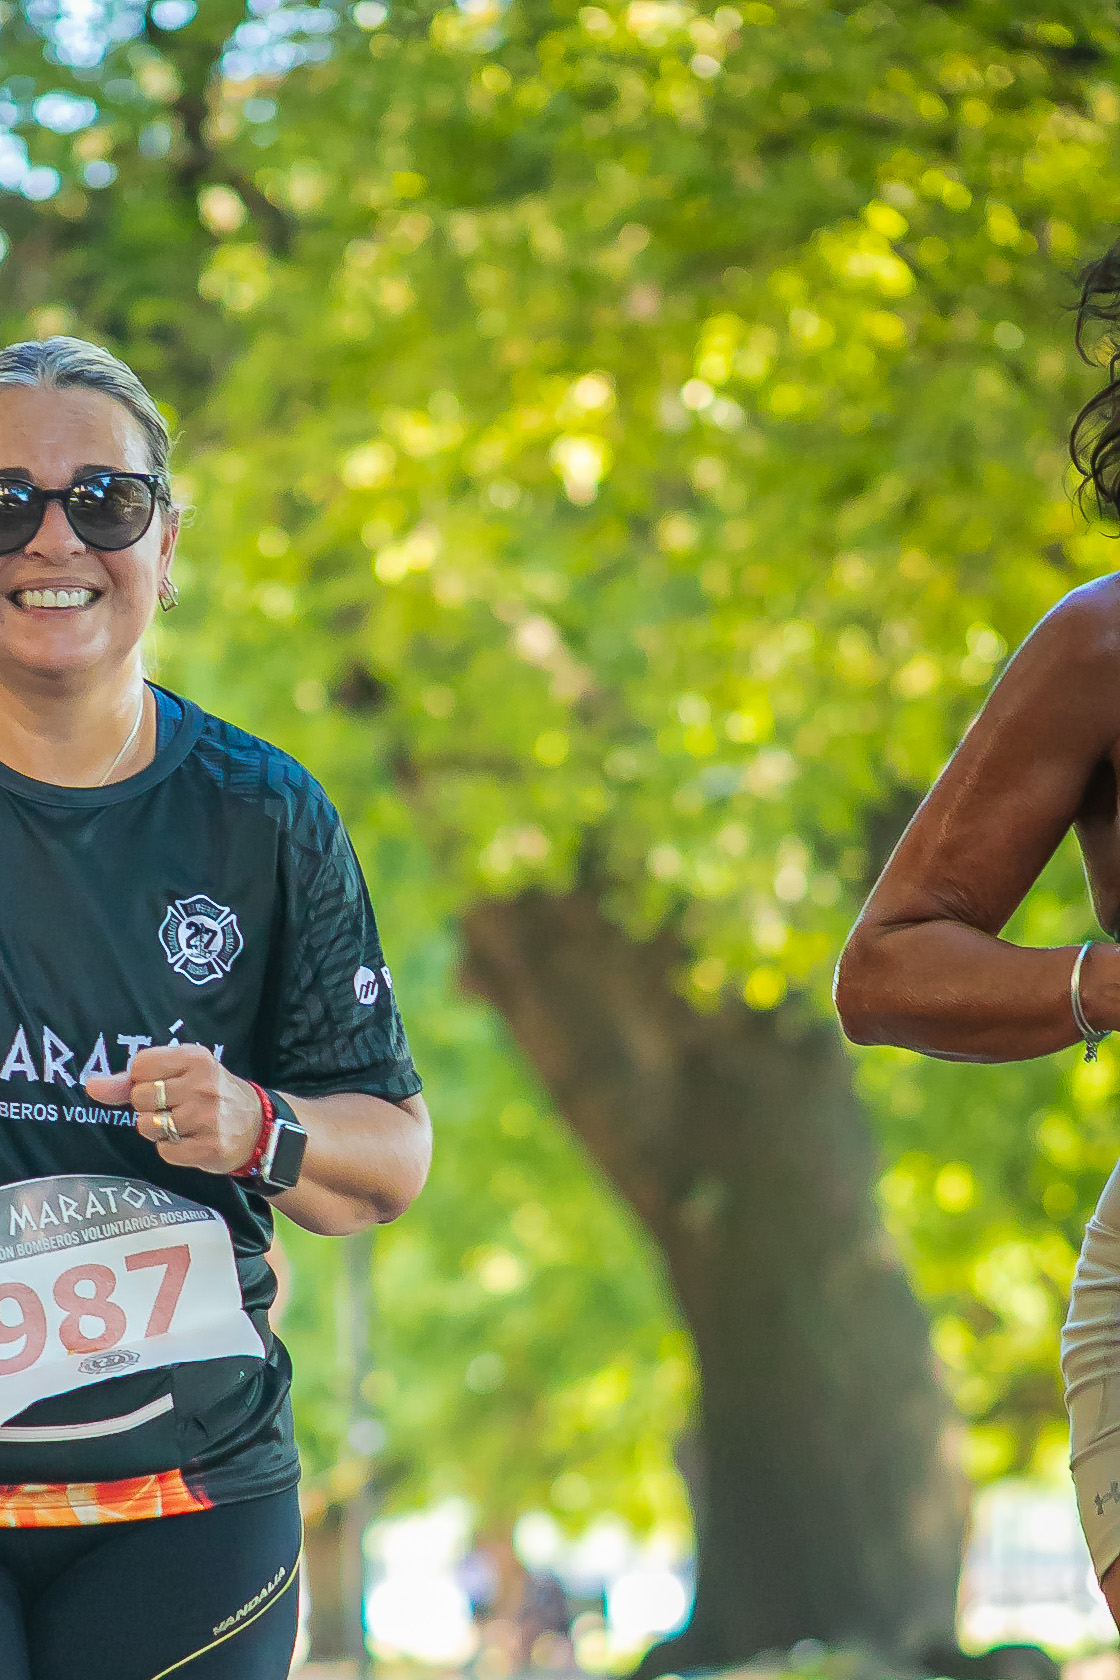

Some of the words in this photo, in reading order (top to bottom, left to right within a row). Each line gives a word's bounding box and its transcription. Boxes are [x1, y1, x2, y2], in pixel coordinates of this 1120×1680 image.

[9, 1182, 173, 1237] MARATÓN
[16, 1229, 81, 1258] BOMBEROS
[80, 1213, 159, 1243] VOLUNTARIOS
